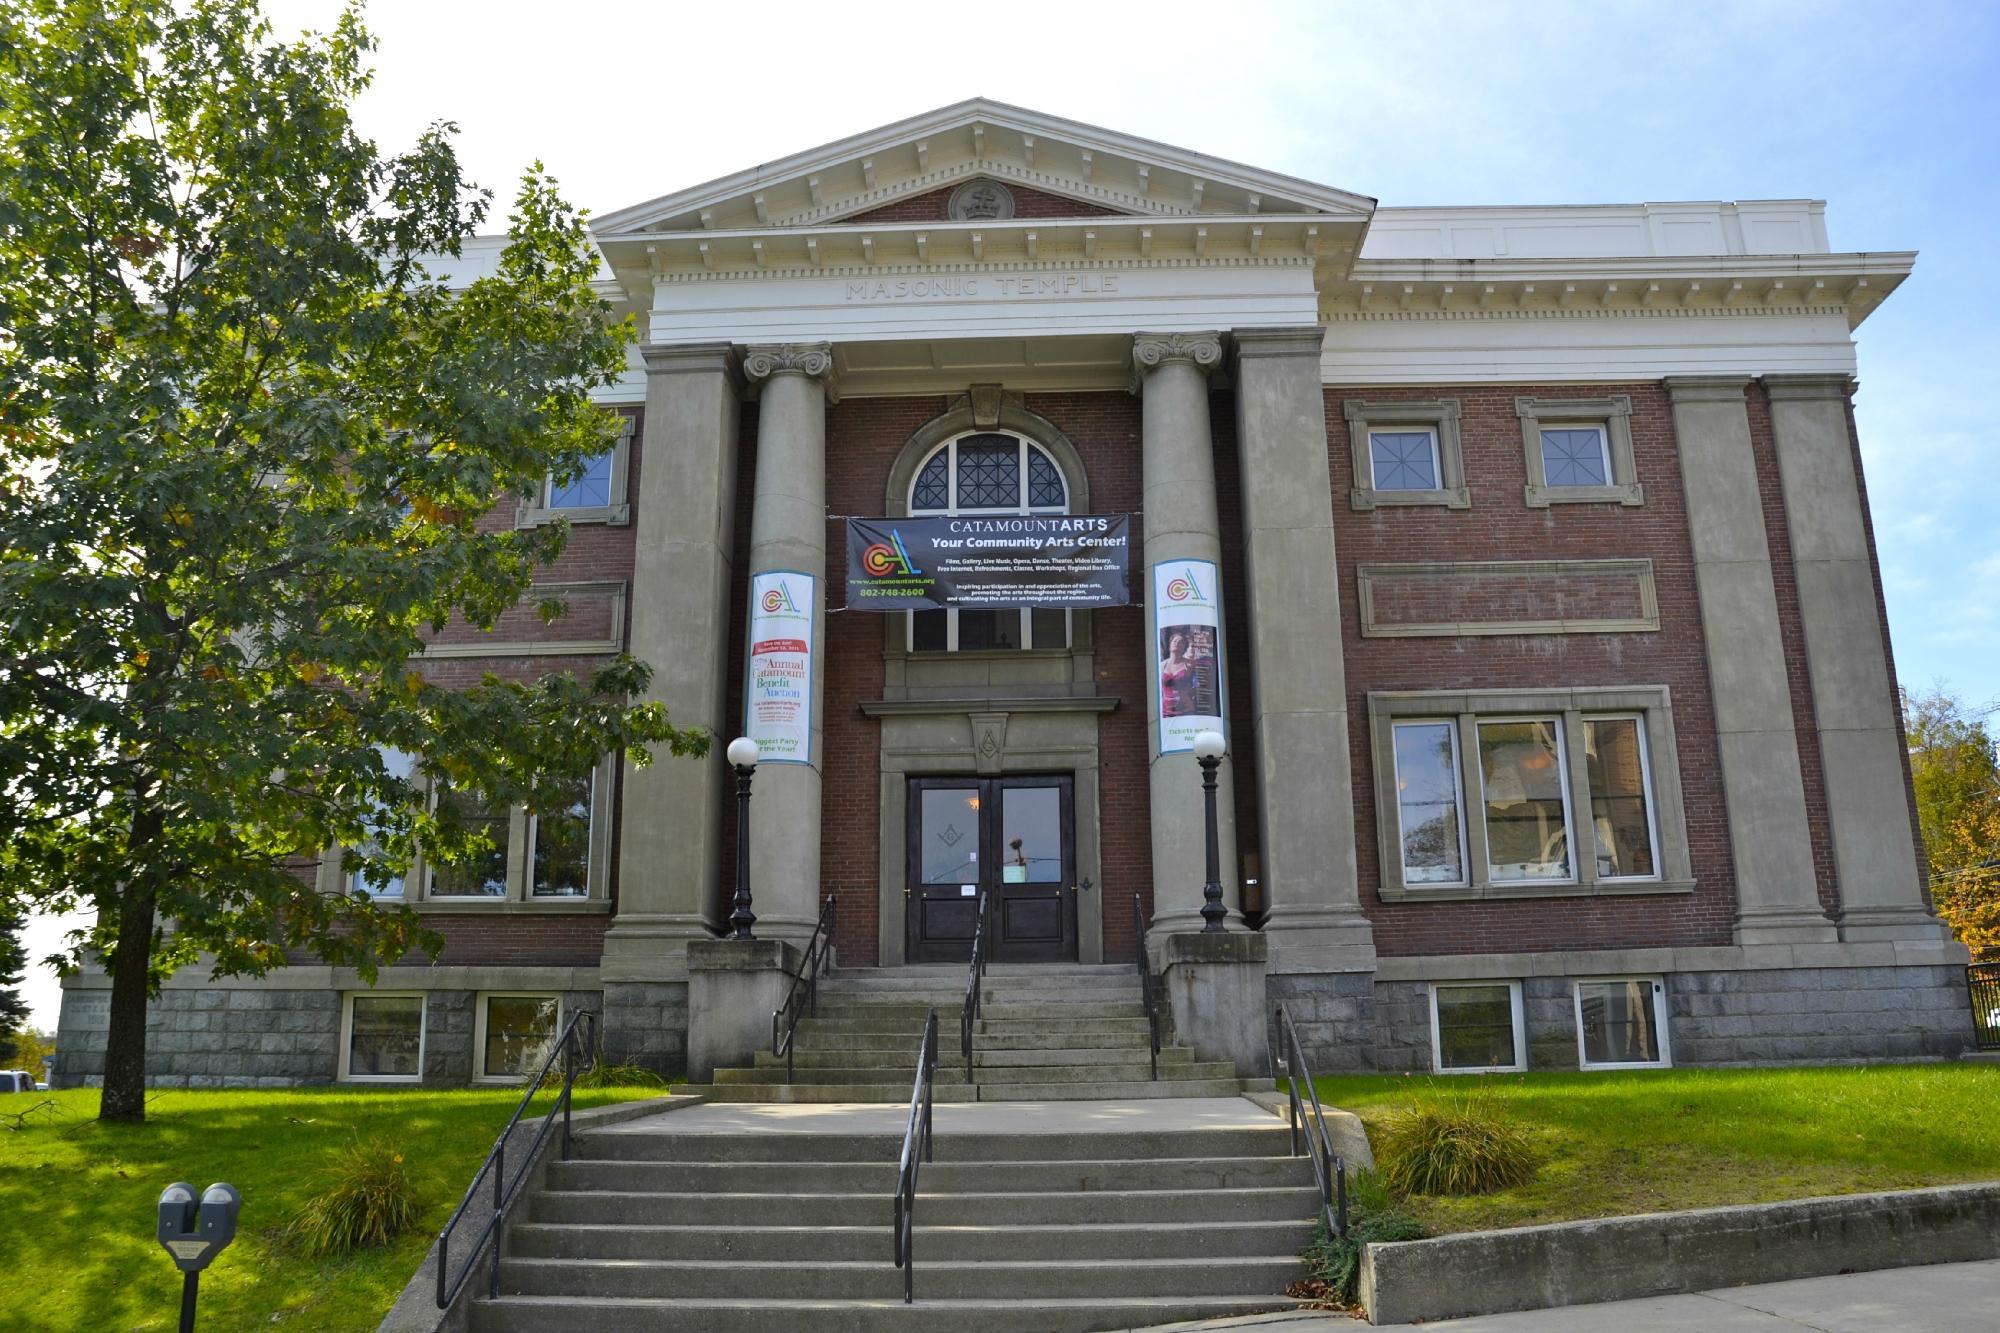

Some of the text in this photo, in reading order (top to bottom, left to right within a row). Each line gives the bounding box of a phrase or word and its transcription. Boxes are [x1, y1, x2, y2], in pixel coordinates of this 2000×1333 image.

[845, 275, 1119, 299] MASONIC TEMPLE
[931, 536, 1126, 550] Your Community Arts Center!
[860, 588, 925, 597] 802-748-2600
[767, 658, 804, 670] Annual
[752, 668, 805, 679] Catamount
[757, 677, 790, 688] Benefit
[763, 687, 800, 698] Auction
